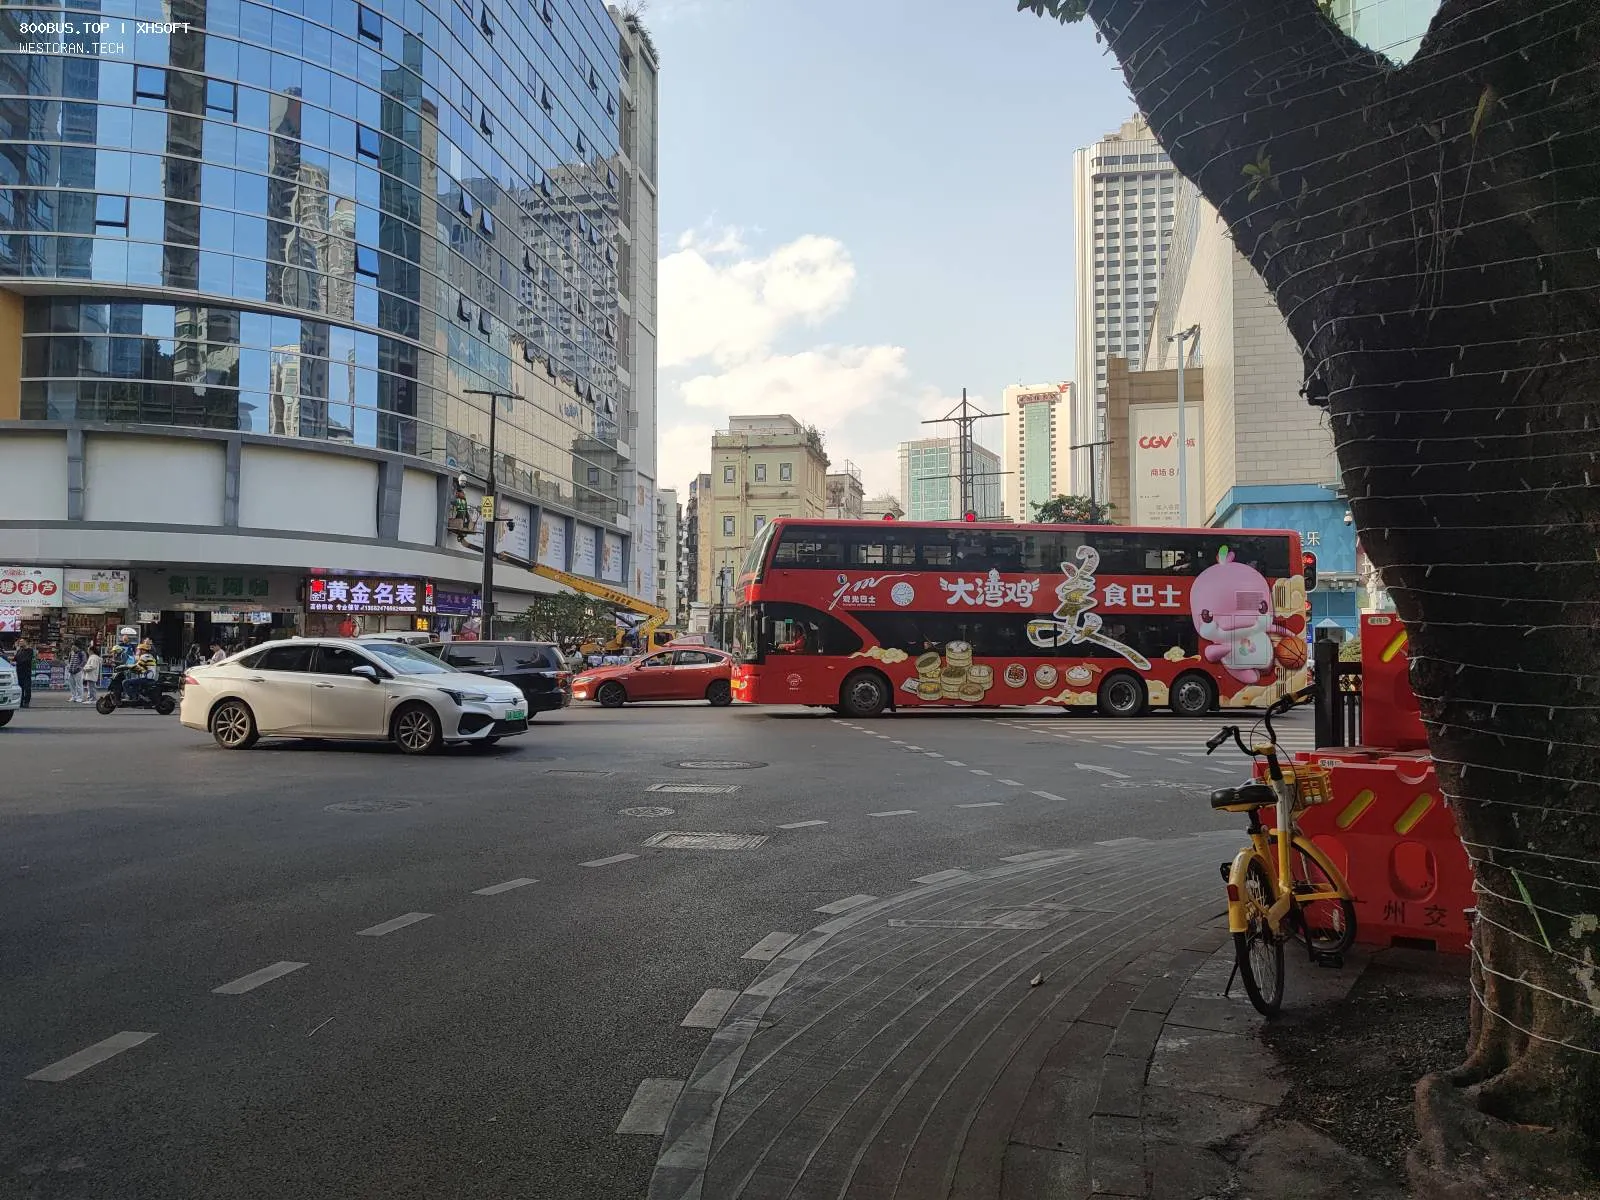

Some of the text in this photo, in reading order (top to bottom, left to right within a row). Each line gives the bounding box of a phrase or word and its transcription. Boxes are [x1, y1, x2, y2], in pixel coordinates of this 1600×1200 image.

[1139, 435, 1172, 449] CGV
[1, 579, 56, 595] 糖葫芦
[327, 581, 417, 604] 黄金名表
[940, 569, 1040, 608] 大湾鸡
[1103, 583, 1182, 607] 食巴士
[842, 595, 876, 603] 观光巴士
